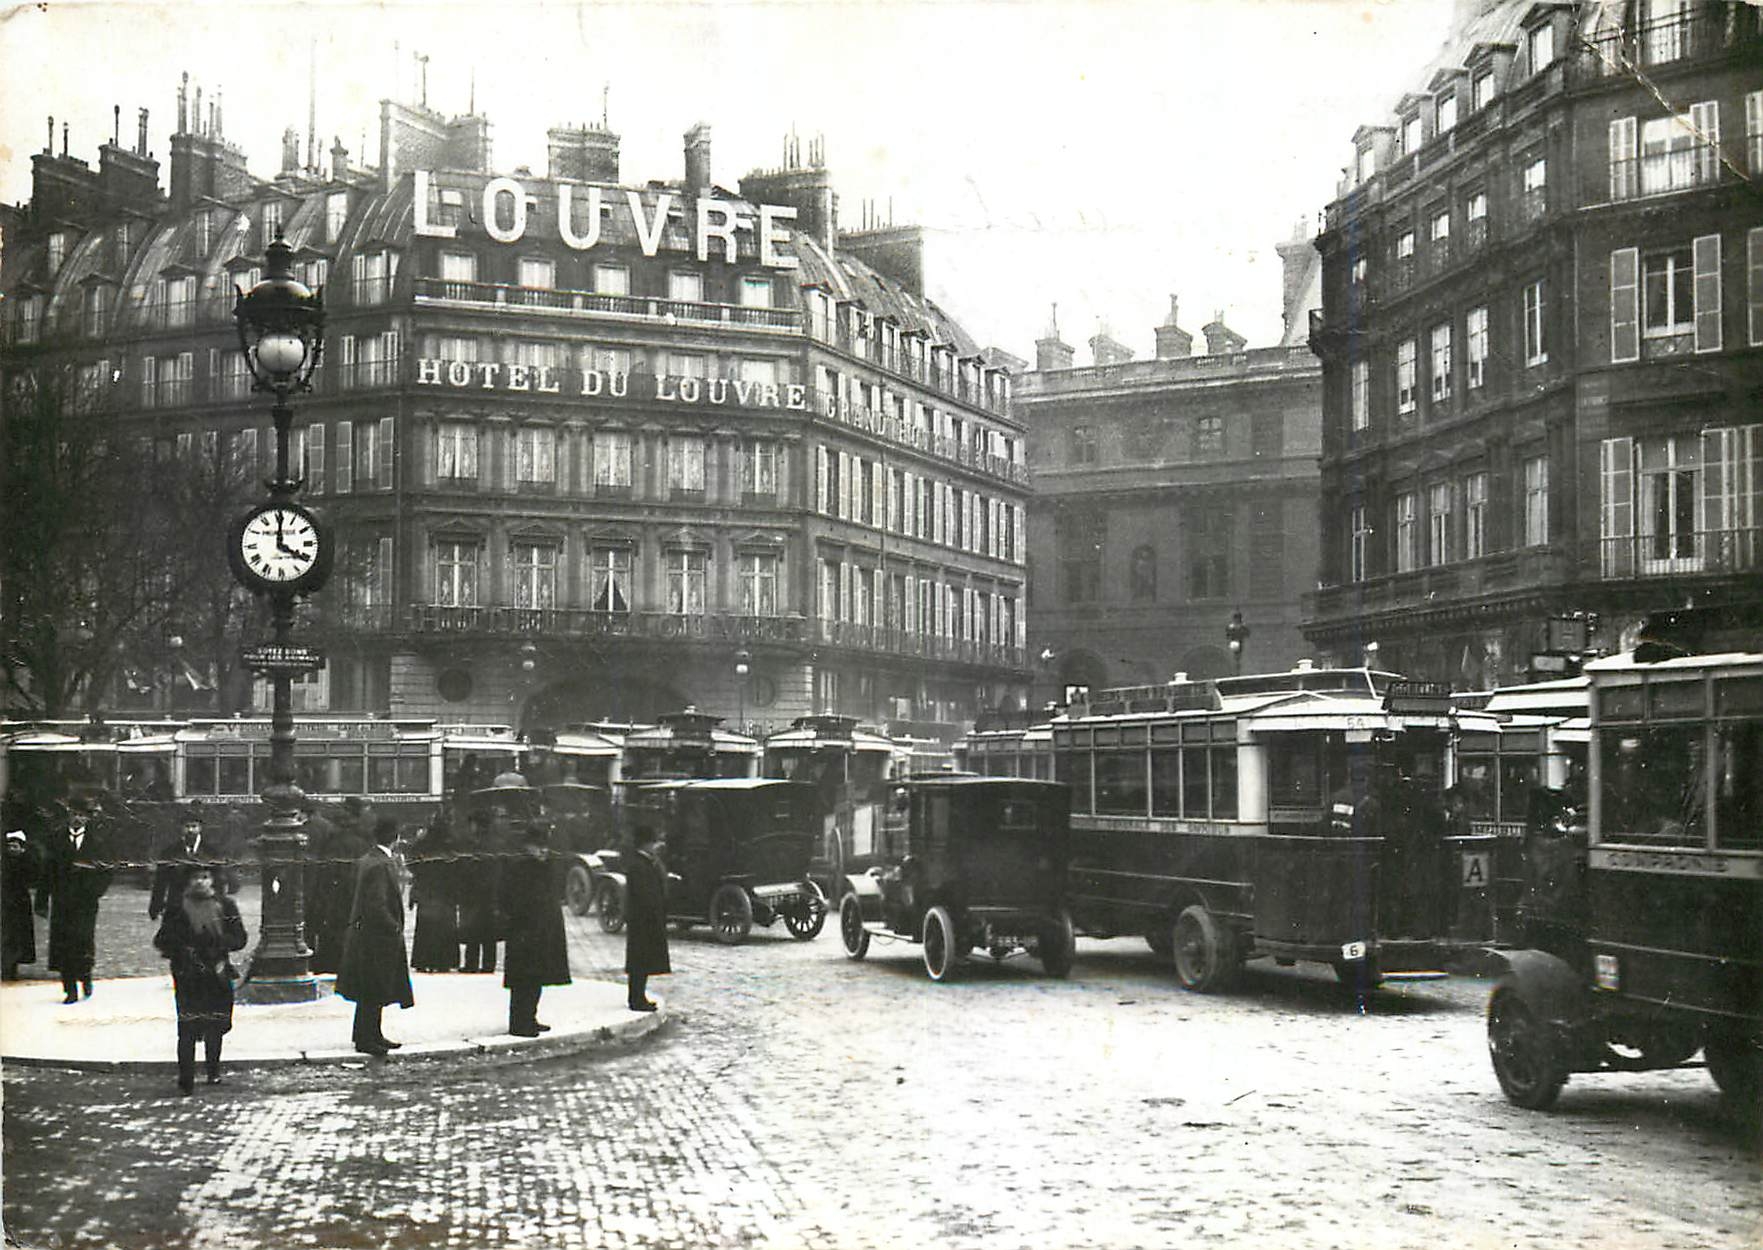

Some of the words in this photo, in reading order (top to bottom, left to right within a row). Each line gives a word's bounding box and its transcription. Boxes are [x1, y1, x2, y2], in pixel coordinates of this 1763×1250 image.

[414, 170, 799, 269] LOUVRE
[416, 358, 560, 393] HOTEL
[581, 371, 629, 397] DU
[655, 374, 807, 410] LOUVRE
[1465, 857, 1485, 882] A
[1350, 945, 1359, 956] 6
